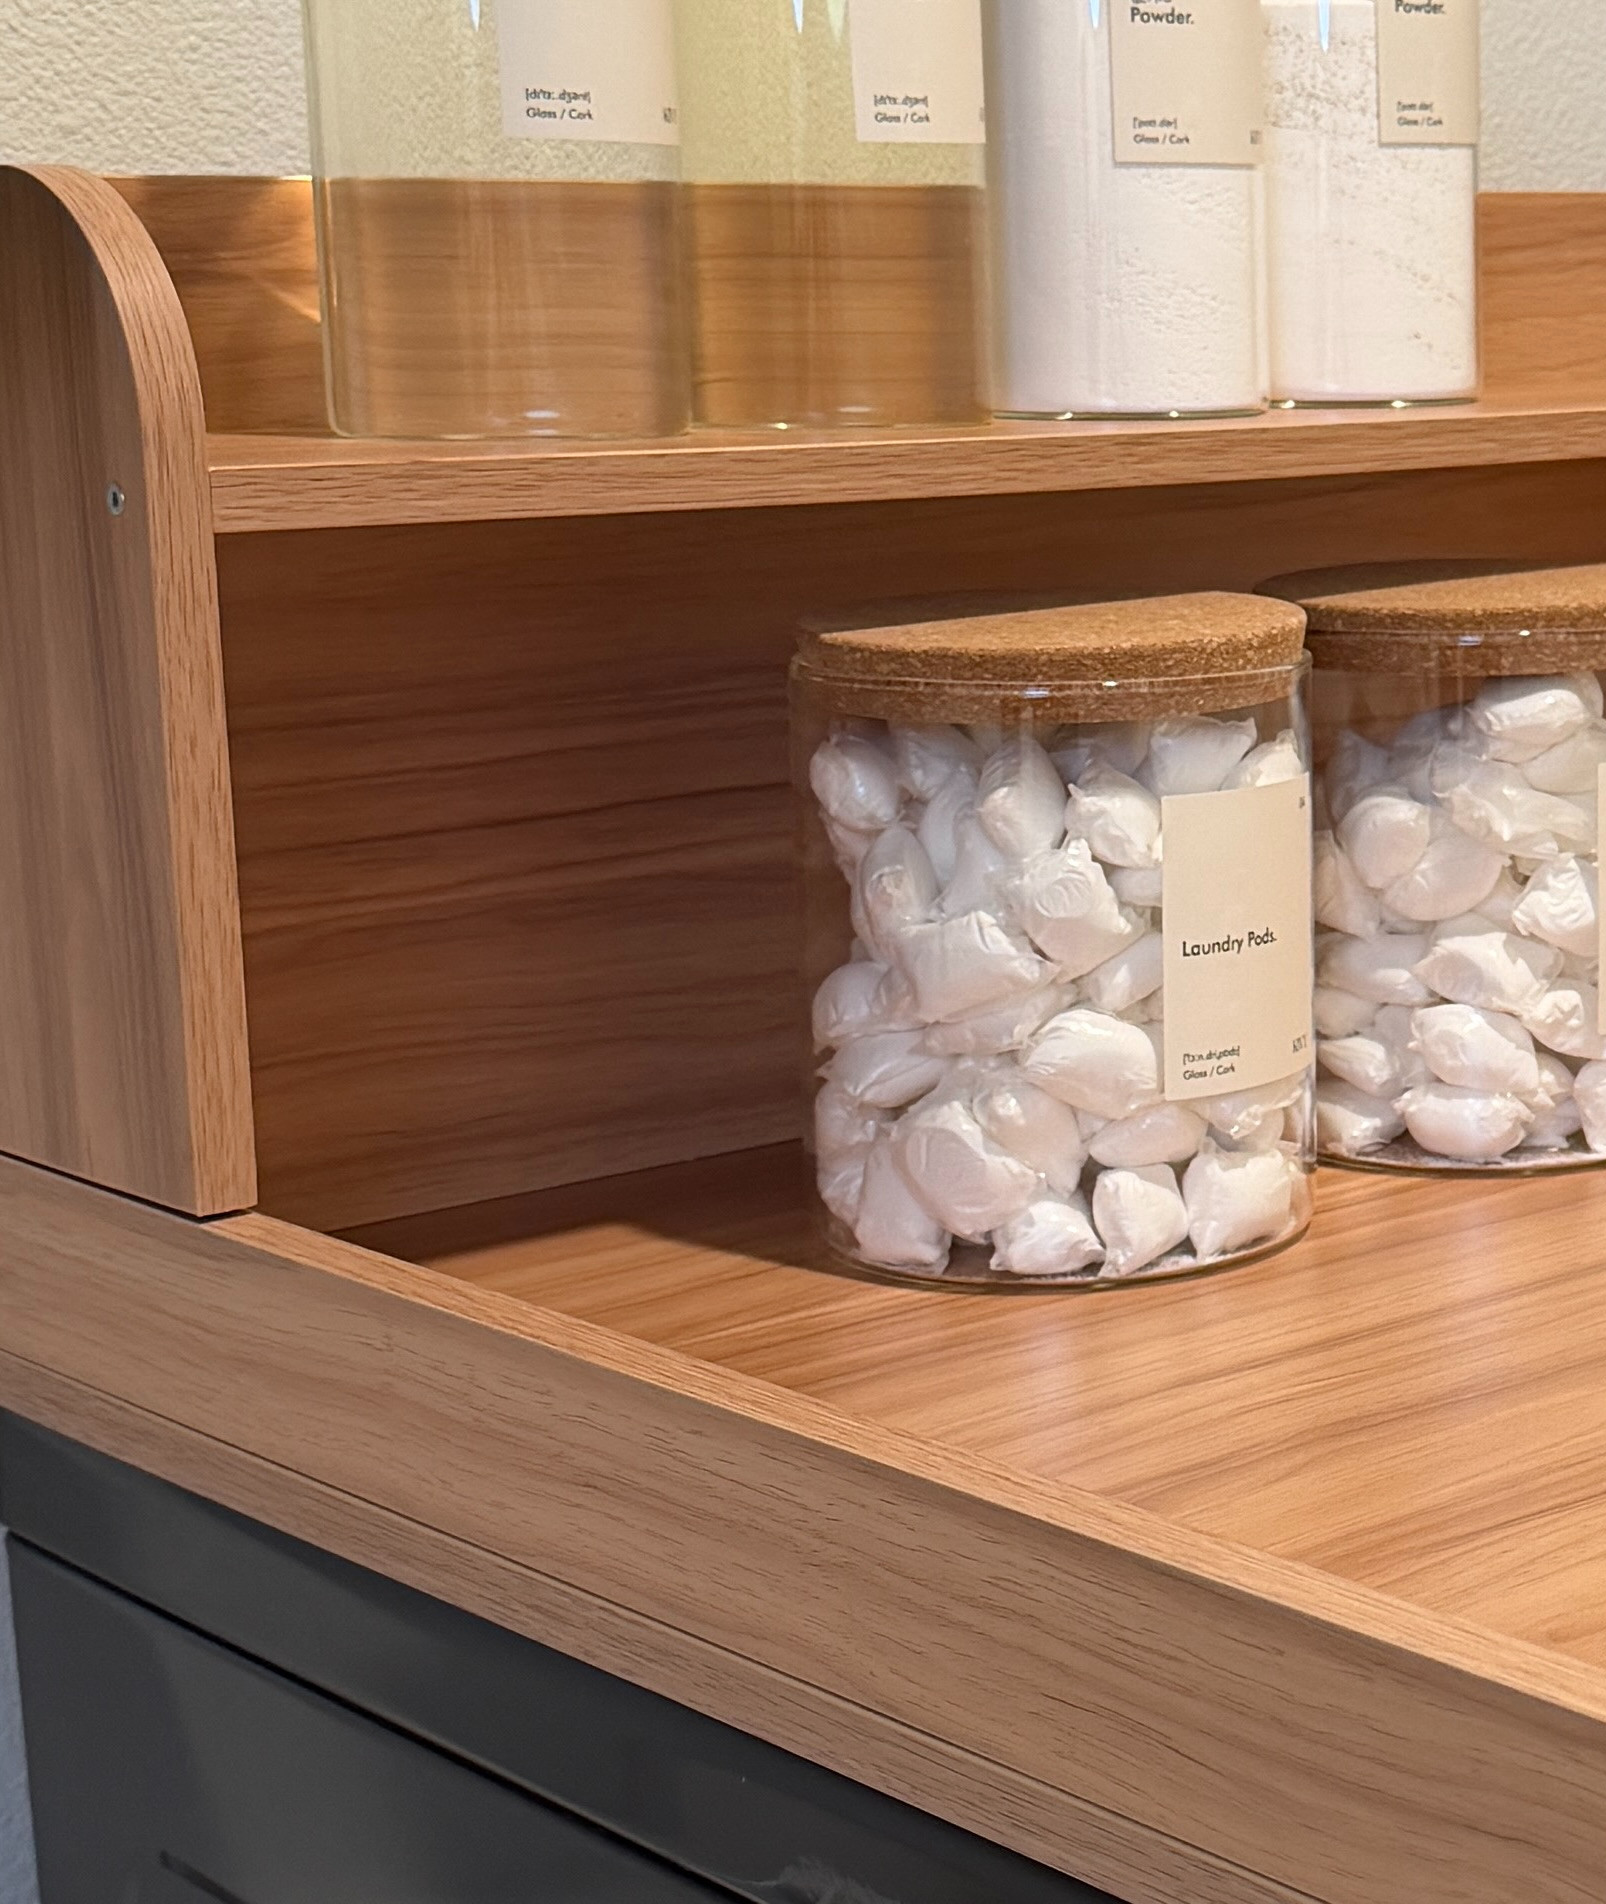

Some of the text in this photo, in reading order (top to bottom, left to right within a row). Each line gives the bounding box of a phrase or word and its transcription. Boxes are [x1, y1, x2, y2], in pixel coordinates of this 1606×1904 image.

[1130, 7, 1194, 25] Powder.
[1182, 927, 1277, 957] Laundry Pods.
